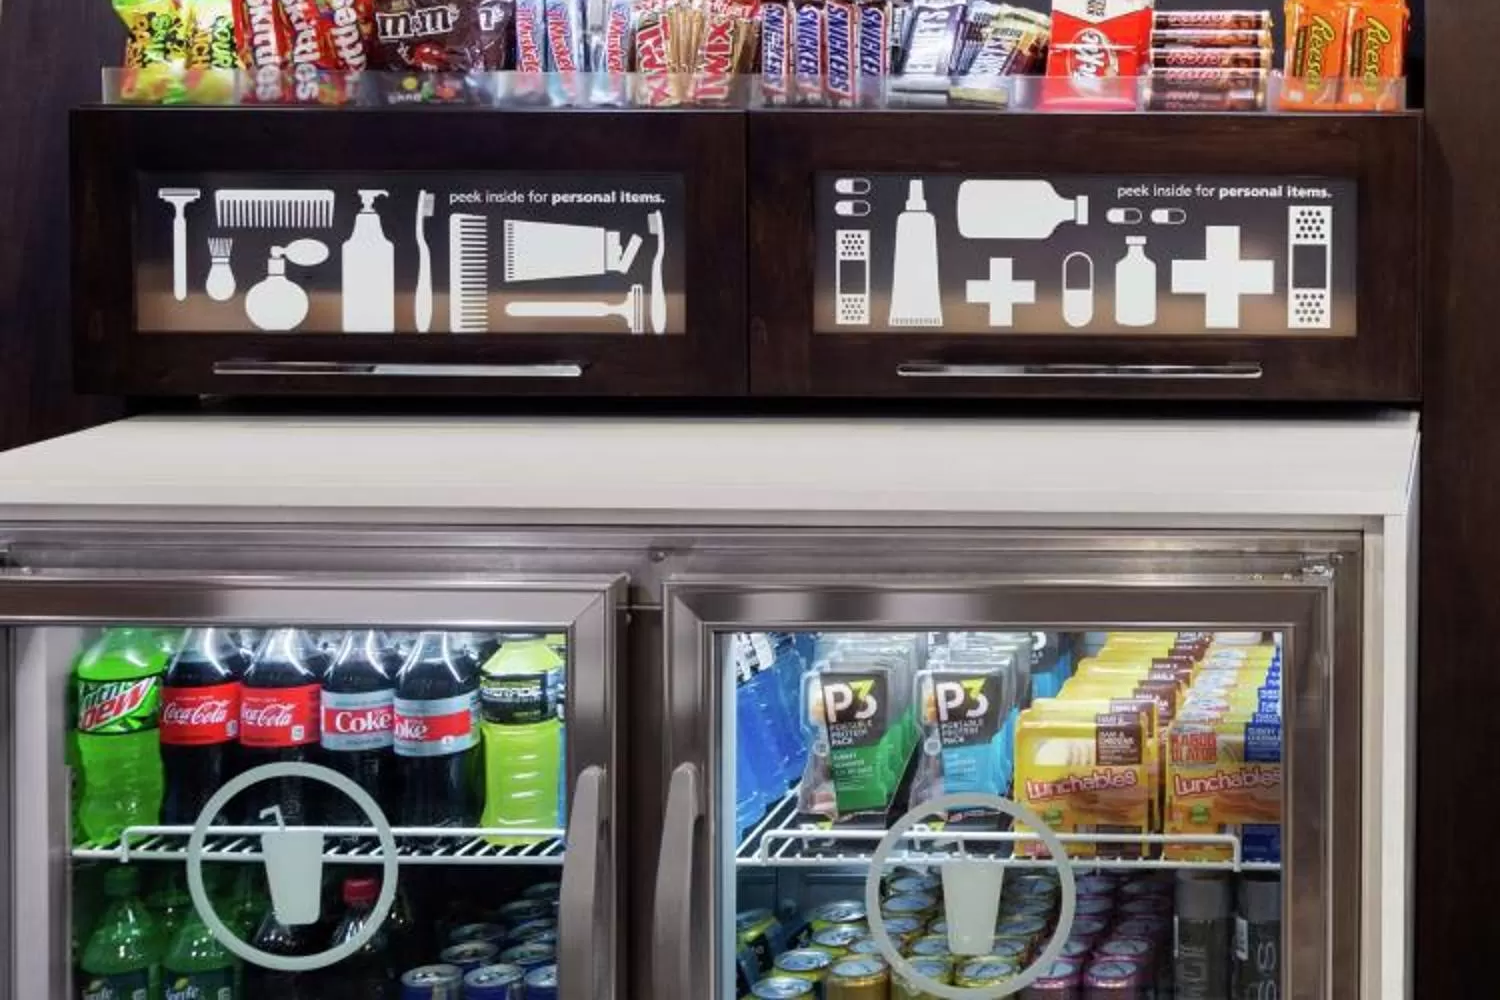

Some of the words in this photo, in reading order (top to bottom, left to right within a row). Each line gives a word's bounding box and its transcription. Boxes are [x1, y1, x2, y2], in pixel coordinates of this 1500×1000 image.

[826, 3, 850, 93] SNICKERS
[860, 7, 884, 78] SNICKE
[450, 189, 482, 205] peek
[485, 189, 525, 204] inside
[528, 189, 549, 203] for
[551, 190, 616, 207] personal
[619, 190, 666, 204] items.
[1117, 184, 1150, 200] peek
[1153, 183, 1193, 198] inside
[1196, 183, 1215, 198] for
[1219, 184, 1283, 201] personal
[1287, 184, 1333, 199] items.
[241, 702, 297, 727] oca-Cola
[823, 678, 879, 724] P3
[935, 678, 990, 722] P3
[334, 709, 393, 734] Coke
[1026, 768, 1137, 800] Lunchables
[1175, 765, 1281, 796] Lunchables
